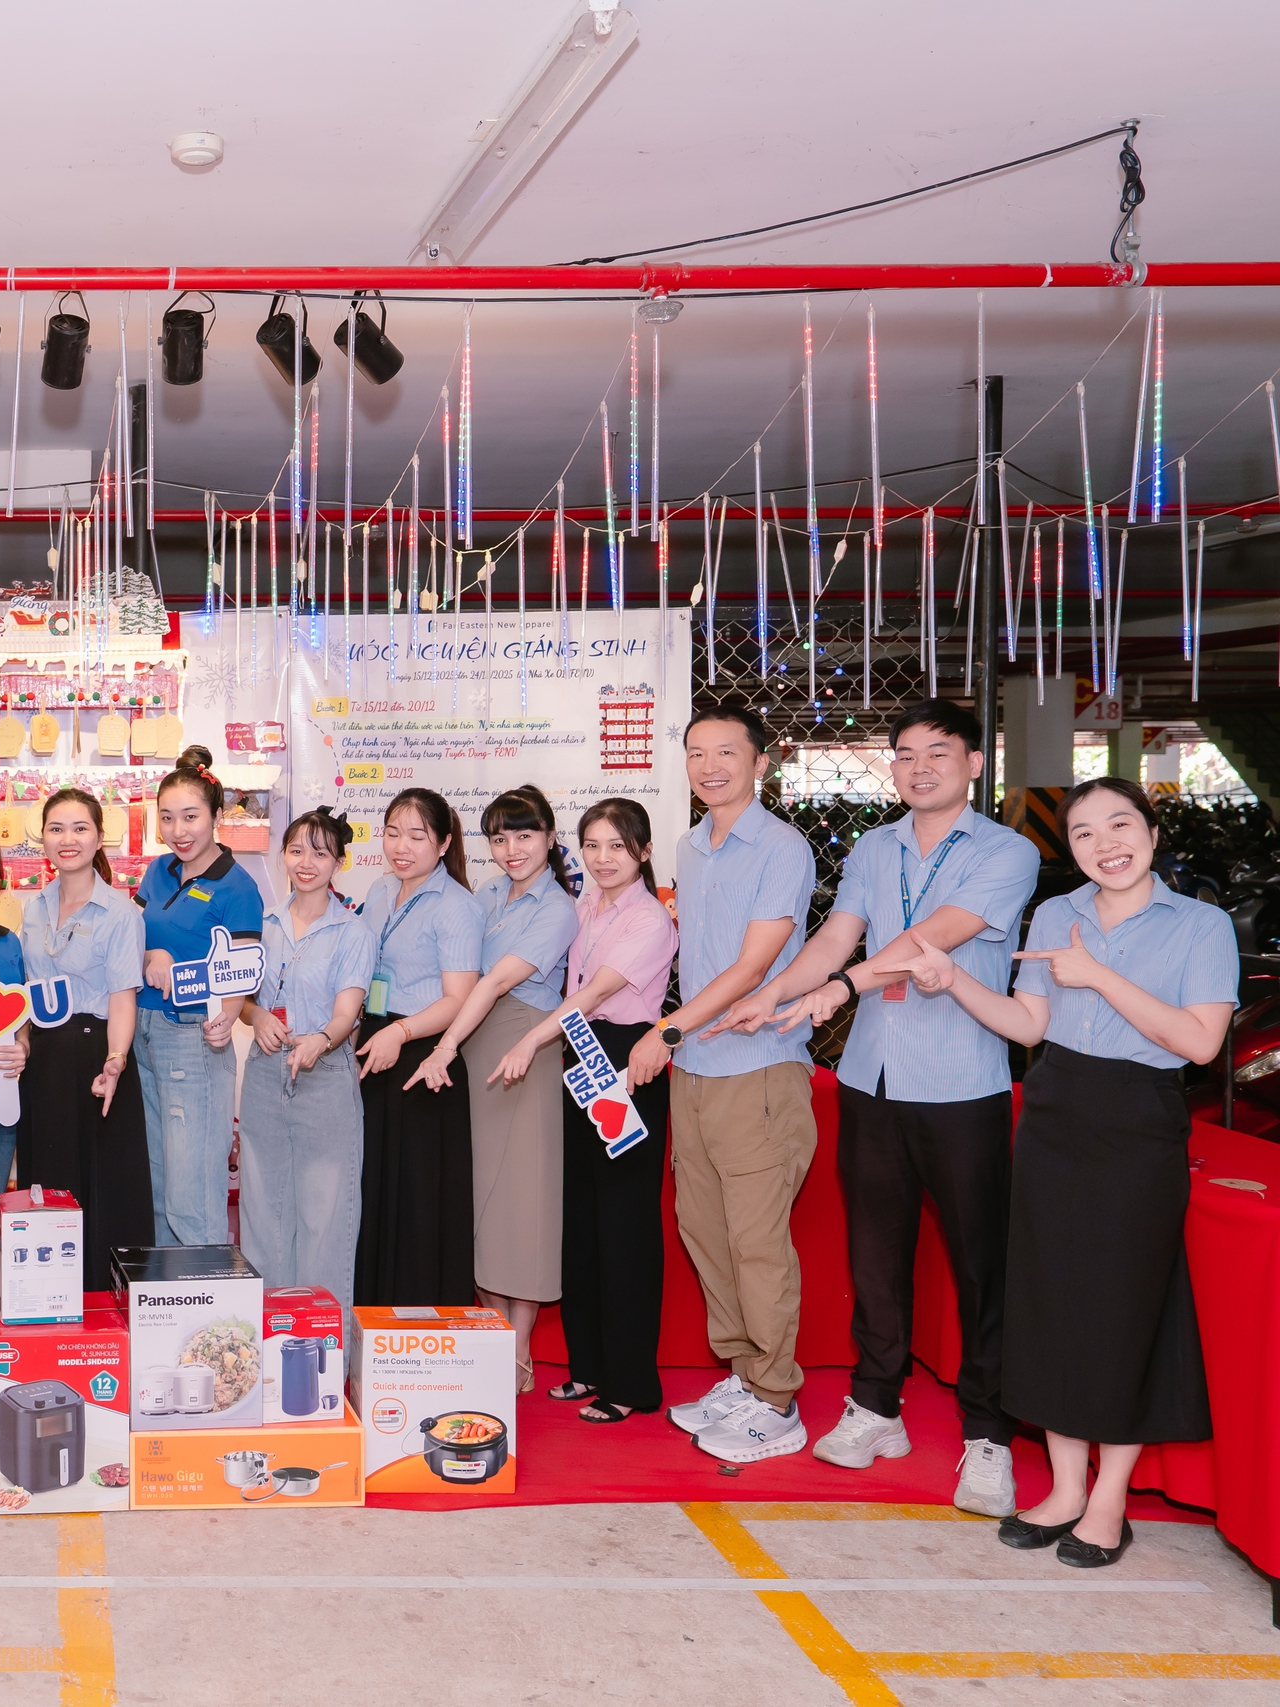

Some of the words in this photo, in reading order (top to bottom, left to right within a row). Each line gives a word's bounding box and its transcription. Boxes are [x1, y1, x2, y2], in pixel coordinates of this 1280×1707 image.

[497, 622, 517, 630] New
[589, 639, 646, 657] SINH
[1075, 678, 1093, 703] C
[363, 701, 388, 713] 15/12
[407, 701, 436, 713] 20/12
[1094, 701, 1119, 720] 18
[520, 736, 549, 748] facebook
[422, 748, 442, 759] trang
[348, 768, 368, 779] Bước
[387, 768, 414, 779] 22/12
[471, 786, 489, 796] tham
[356, 854, 383, 866] 24/12
[214, 960, 230, 971] FAR
[176, 968, 197, 981] HÃY
[215, 968, 255, 983] EASTERN
[178, 982, 206, 995] CHỌN
[30, 979, 69, 1022] U
[561, 1011, 618, 1092] EASTERN
[567, 1066, 598, 1105] FAR
[138, 1292, 214, 1307] Panasonic
[373, 1335, 457, 1354] SUPOR
[373, 1358, 389, 1366] Fast
[391, 1358, 421, 1366] Cooking
[424, 1358, 450, 1366] Electric
[452, 1358, 474, 1366] Hotpot
[96, 1378, 111, 1389] 12
[373, 1382, 397, 1391] Quick
[399, 1382, 415, 1391] and
[417, 1382, 463, 1391] convenient
[141, 1471, 174, 1482] Hawo
[176, 1470, 204, 1483] Gigu
